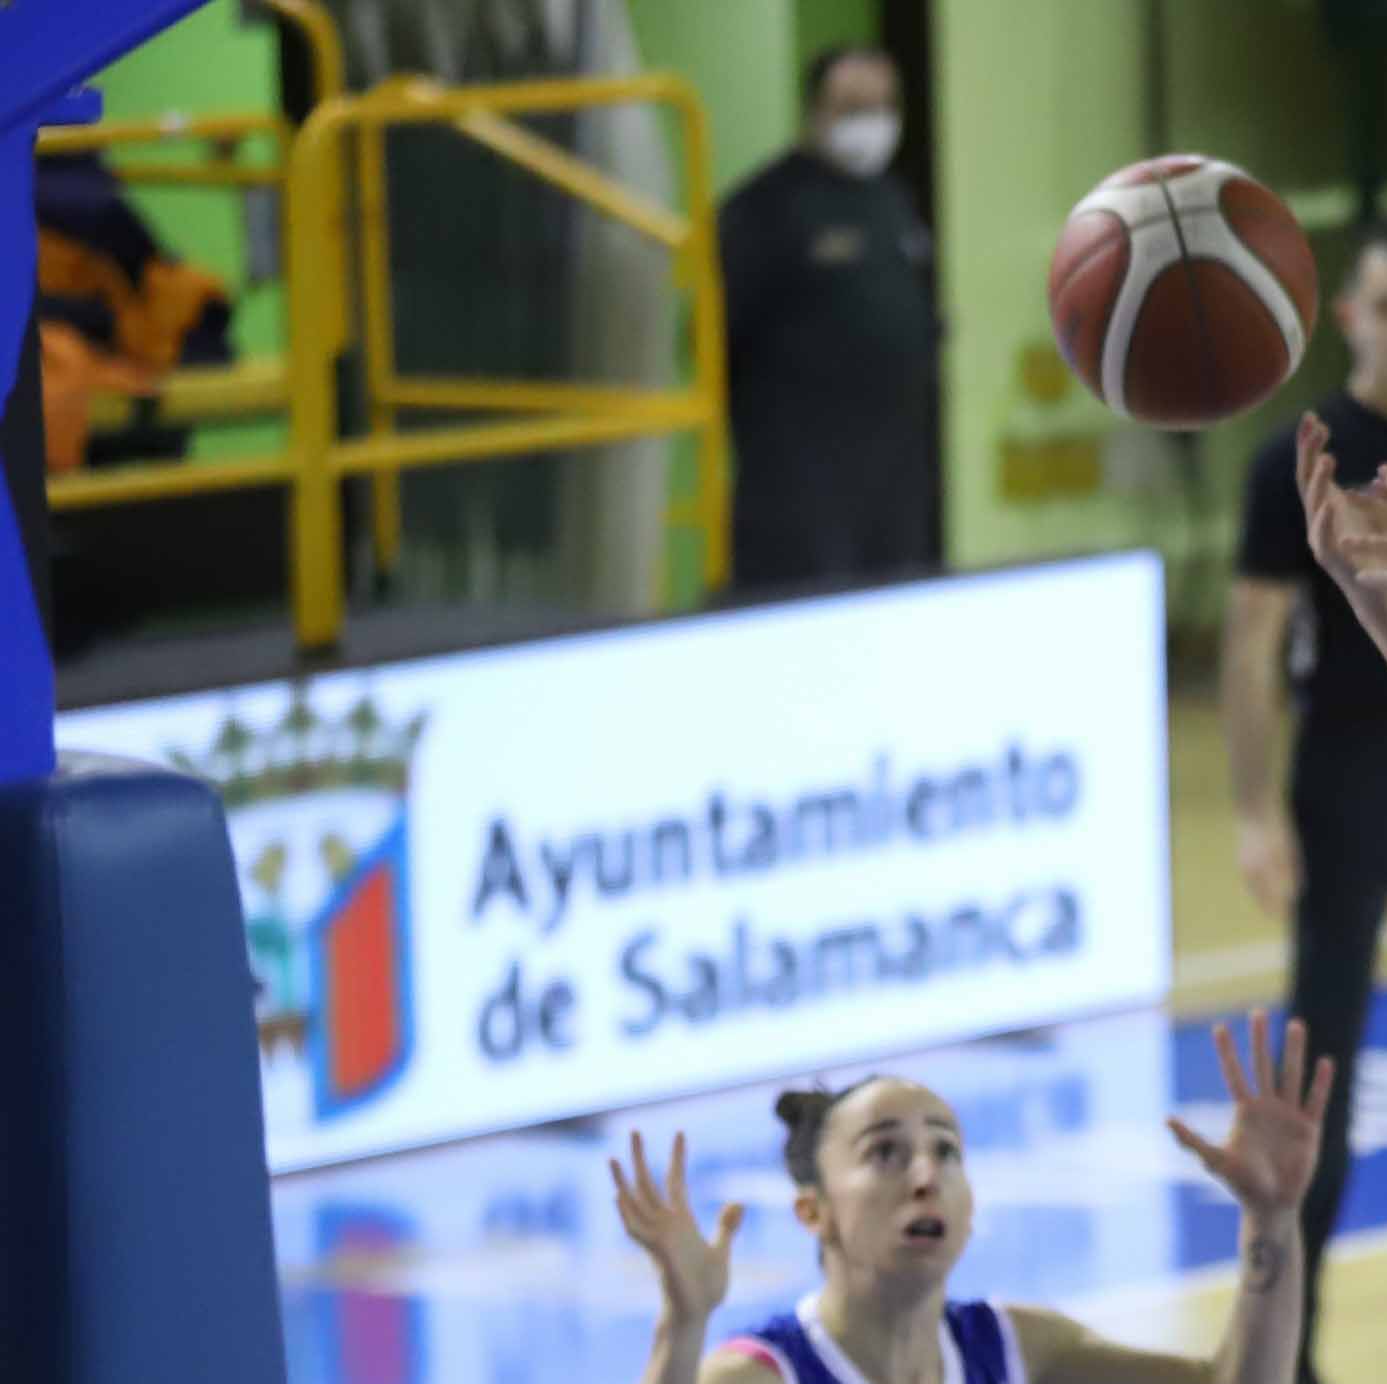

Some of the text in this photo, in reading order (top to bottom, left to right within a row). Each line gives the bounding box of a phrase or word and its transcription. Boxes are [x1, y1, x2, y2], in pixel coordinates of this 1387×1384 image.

[473, 740, 1080, 936] Ayuntamiento
[480, 888, 1080, 1060] de Salamanca
